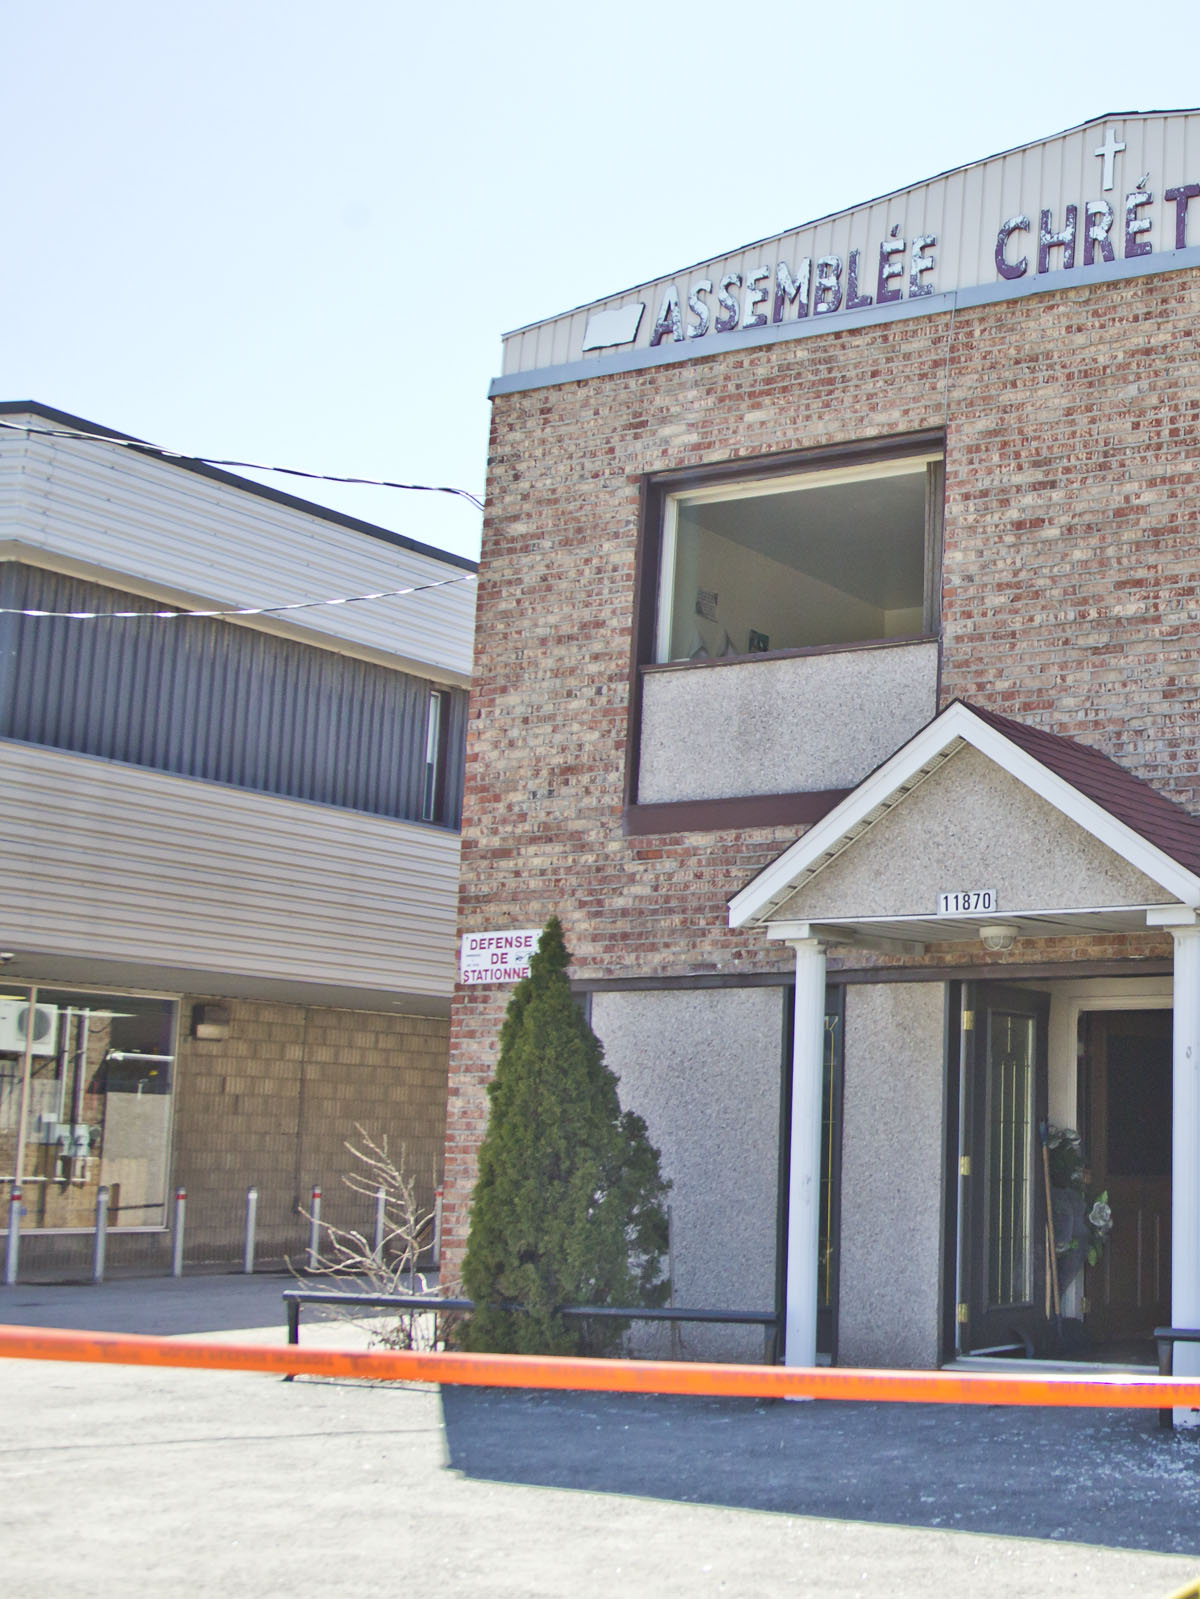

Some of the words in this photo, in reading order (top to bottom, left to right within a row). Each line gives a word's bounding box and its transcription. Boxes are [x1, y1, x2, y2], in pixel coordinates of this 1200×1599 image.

[650, 224, 936, 347] ASSEMBLÉE
[943, 892, 992, 912] 11870
[491, 952, 508, 965] DE
[463, 967, 529, 983] STATIONNE
